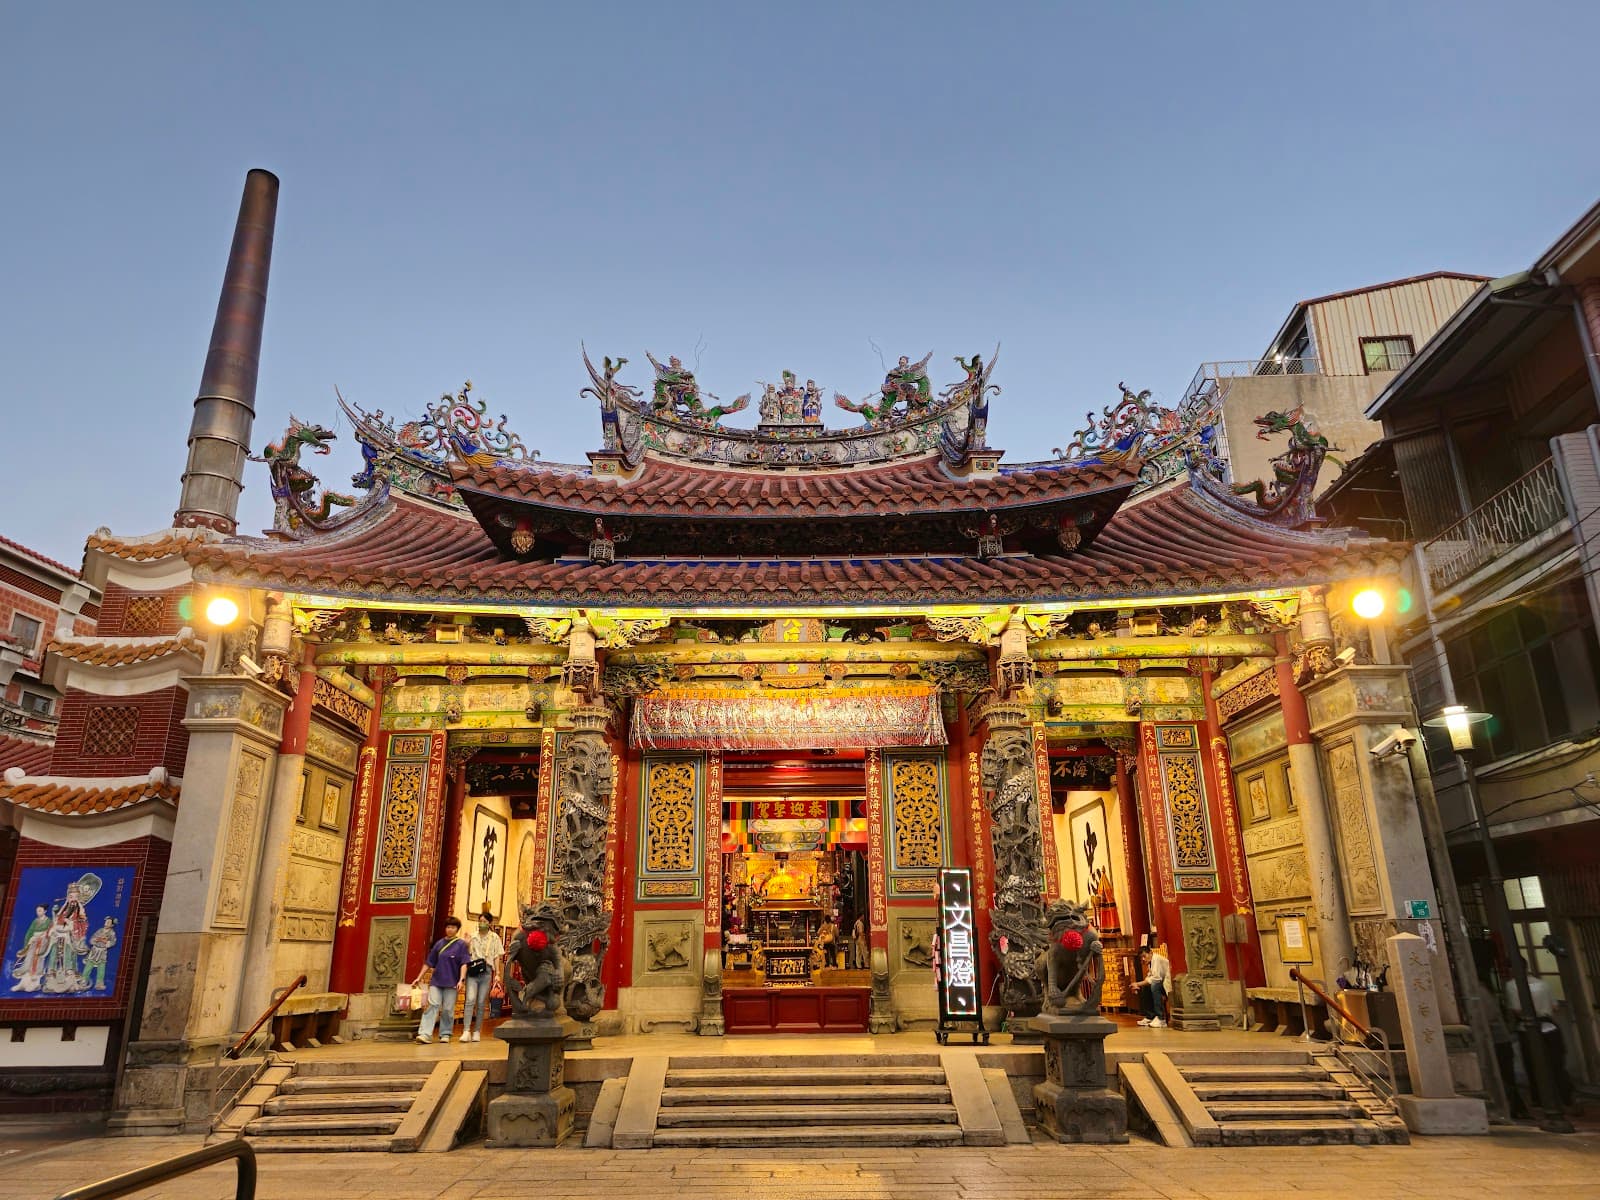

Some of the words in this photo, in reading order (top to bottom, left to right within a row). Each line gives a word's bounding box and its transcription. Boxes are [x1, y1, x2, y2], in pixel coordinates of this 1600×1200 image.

[757, 802, 825, 818] 恭迎聖駕
[945, 902, 974, 986] 文昌燈
